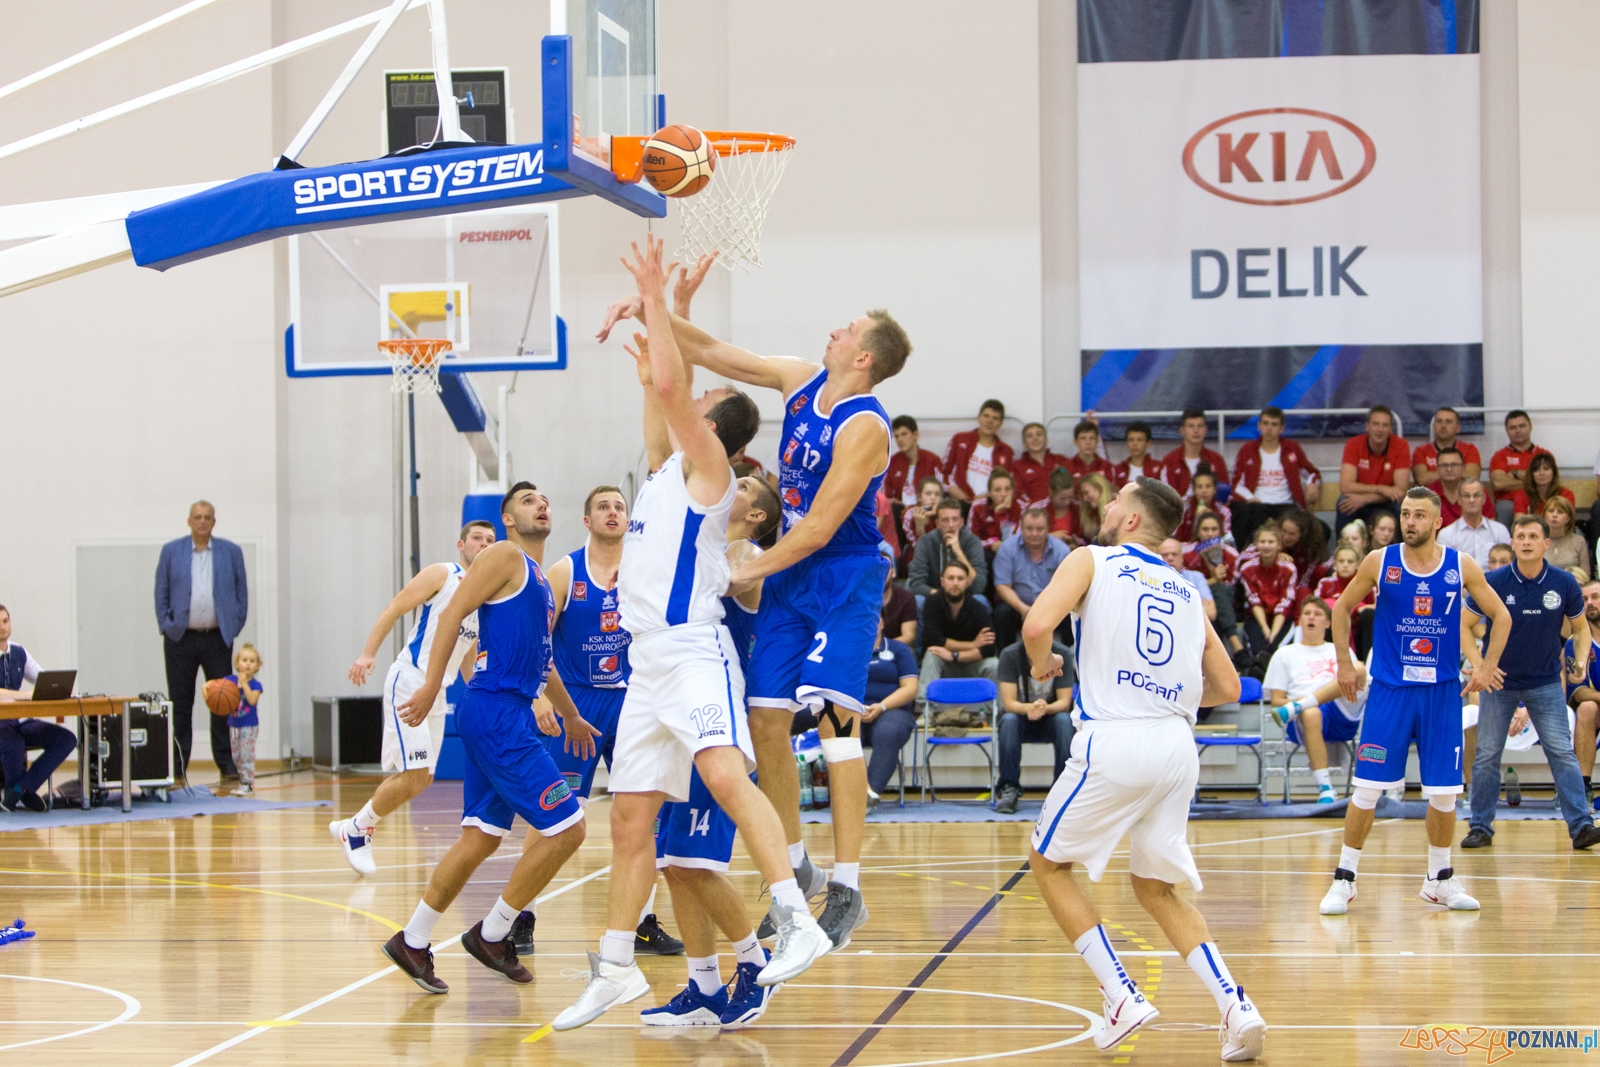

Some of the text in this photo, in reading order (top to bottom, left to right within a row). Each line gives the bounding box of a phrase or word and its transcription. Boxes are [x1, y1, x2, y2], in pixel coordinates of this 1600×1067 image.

[1215, 130, 1344, 183] KIA
[459, 229, 533, 243] PESMENPOL
[1190, 246, 1369, 299] DELIK
[1445, 591, 1458, 615] 7
[1136, 593, 1175, 667] 6
[1396, 624, 1448, 635] INOWROCŁAW
[1402, 616, 1442, 627] KSK NOTEĆ
[588, 634, 604, 644] KSK
[1403, 655, 1436, 663] INENERGIA
[690, 703, 727, 733] 12
[414, 750, 428, 761] PBG
[689, 807, 711, 837] 14
